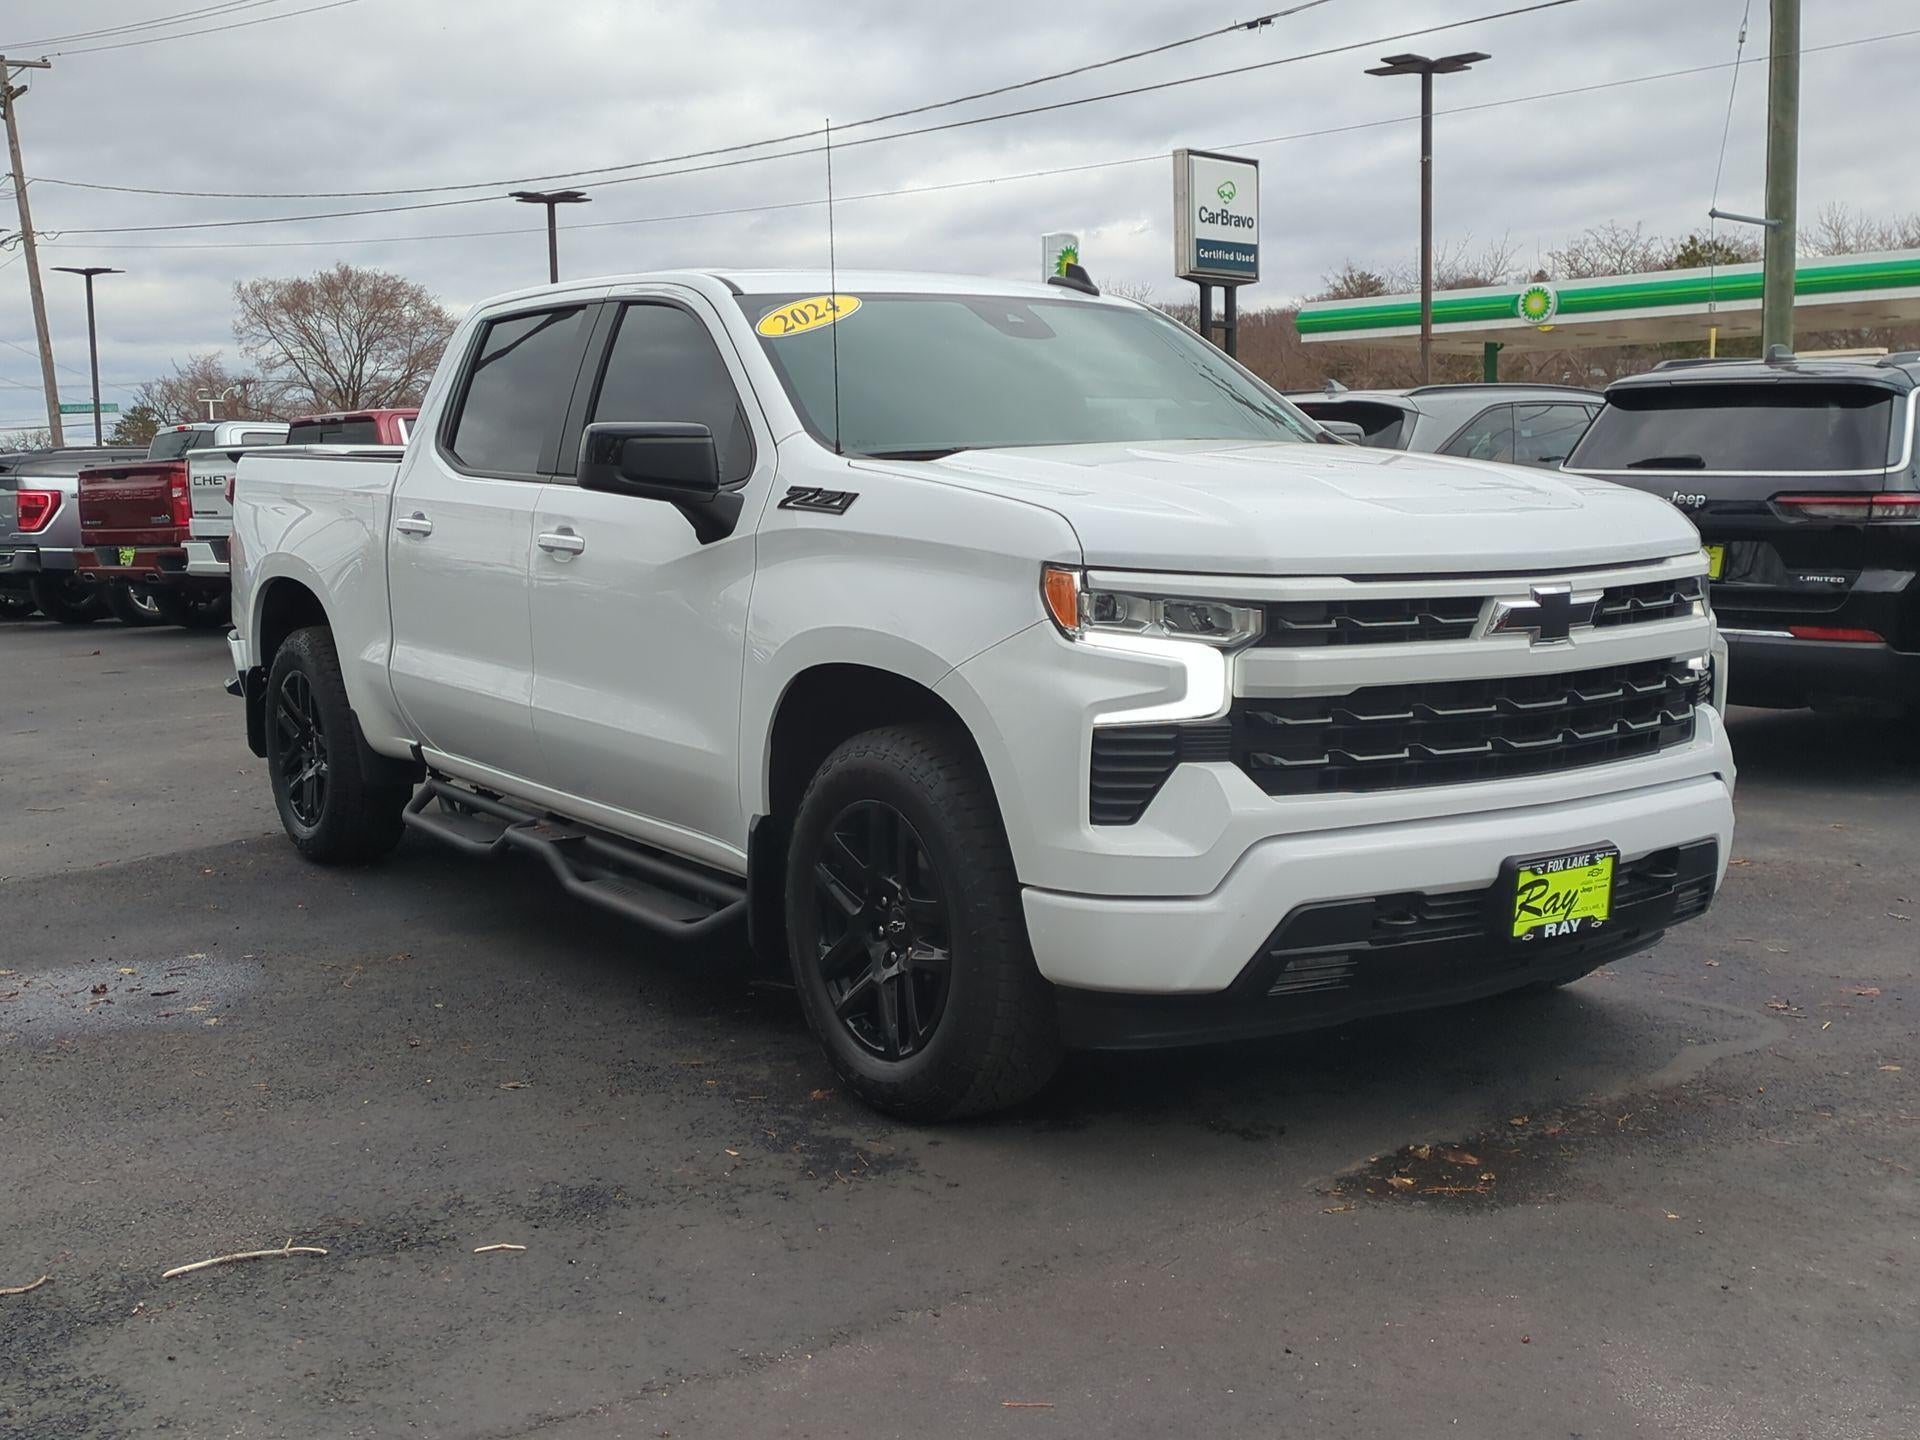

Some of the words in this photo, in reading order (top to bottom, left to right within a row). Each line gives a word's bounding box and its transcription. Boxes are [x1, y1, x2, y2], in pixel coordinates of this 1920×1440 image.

[1199, 206, 1255, 229] CarBravo
[1199, 248, 1234, 261] Certified
[1236, 252, 1255, 263] Used
[773, 297, 841, 333] 2024
[1666, 490, 1706, 508] Jeep
[1799, 575, 1845, 584] LIMITED
[1547, 859, 1565, 873] FOX
[1566, 855, 1591, 869] LAKE
[1514, 878, 1580, 920] Ray
[1544, 919, 1582, 938] RAY
